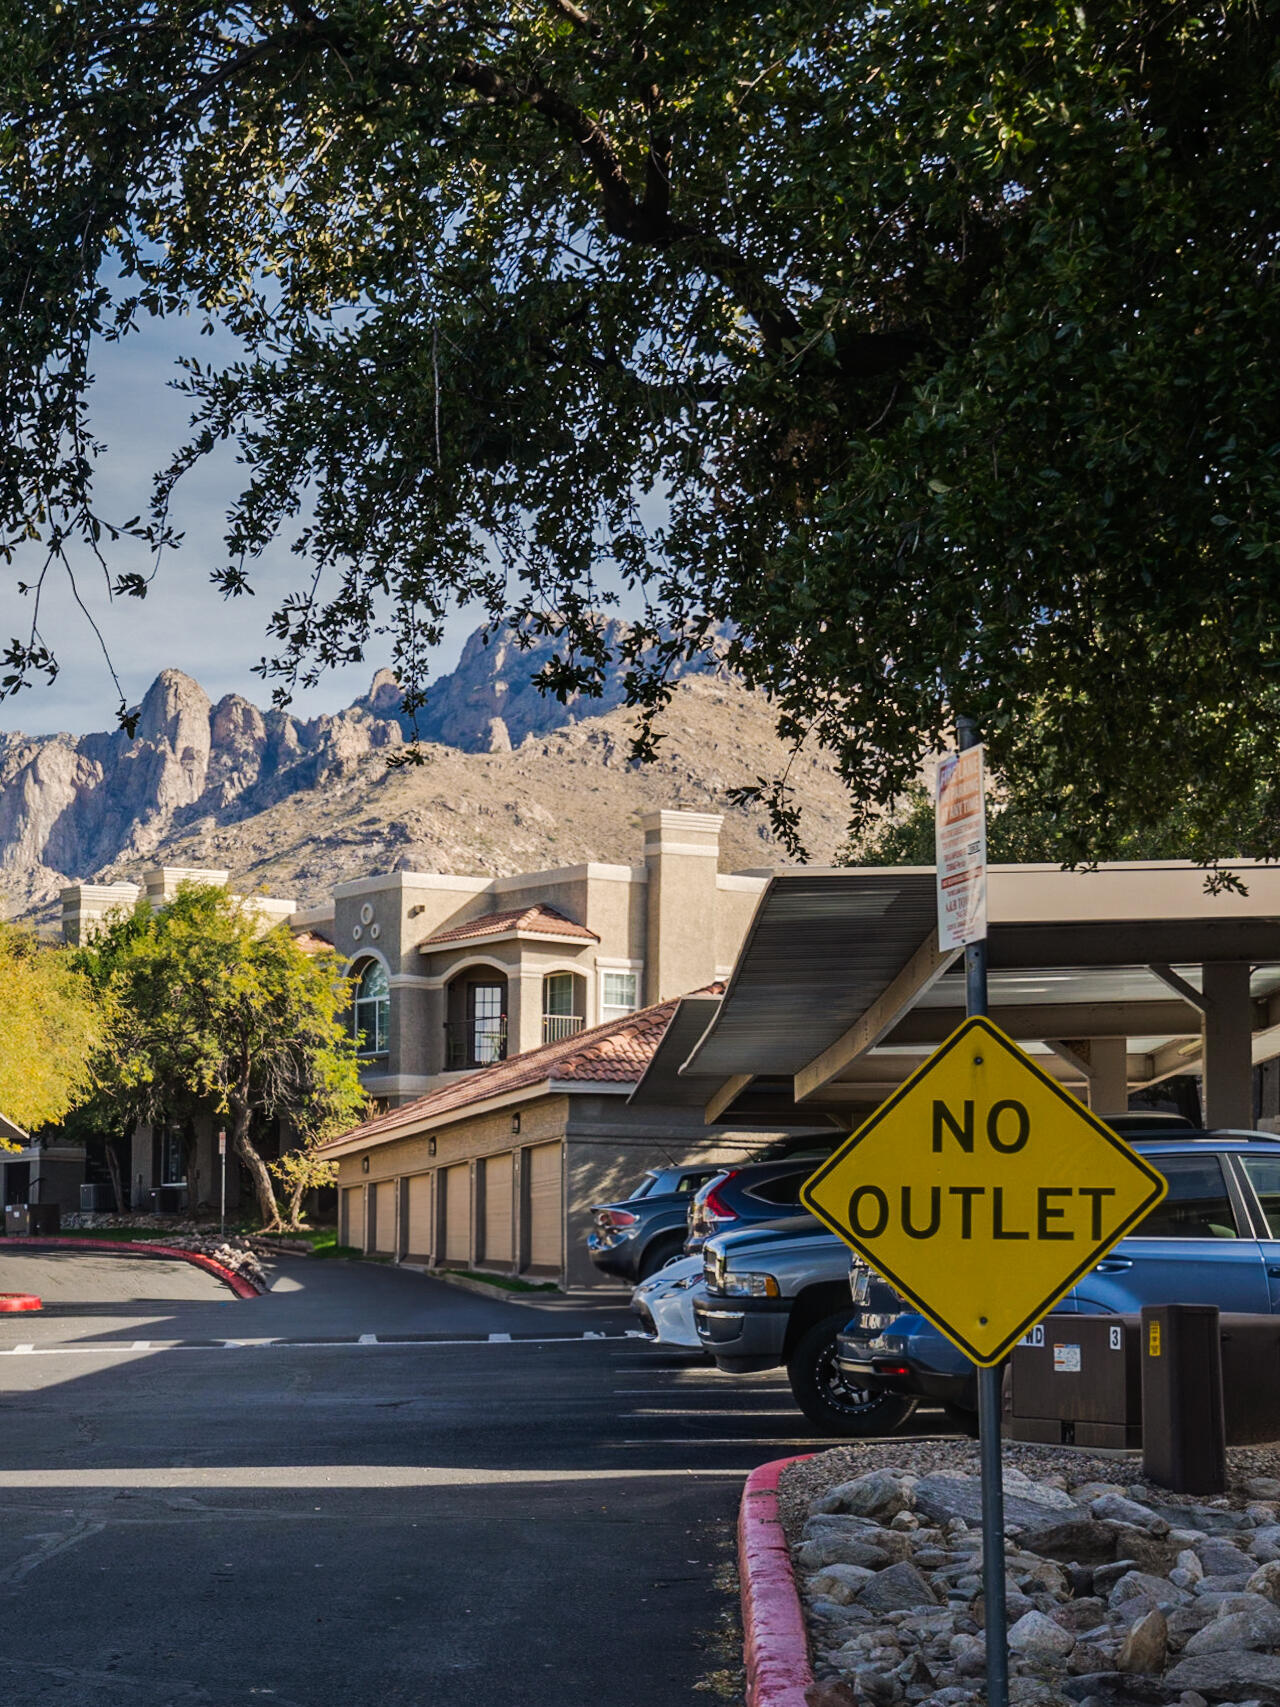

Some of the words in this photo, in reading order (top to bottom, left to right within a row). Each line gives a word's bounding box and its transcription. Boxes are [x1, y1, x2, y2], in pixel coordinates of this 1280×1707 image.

[933, 1100, 1030, 1154] NO
[848, 1186, 1116, 1241] OUTLET
[1112, 1330, 1119, 1346] 3
